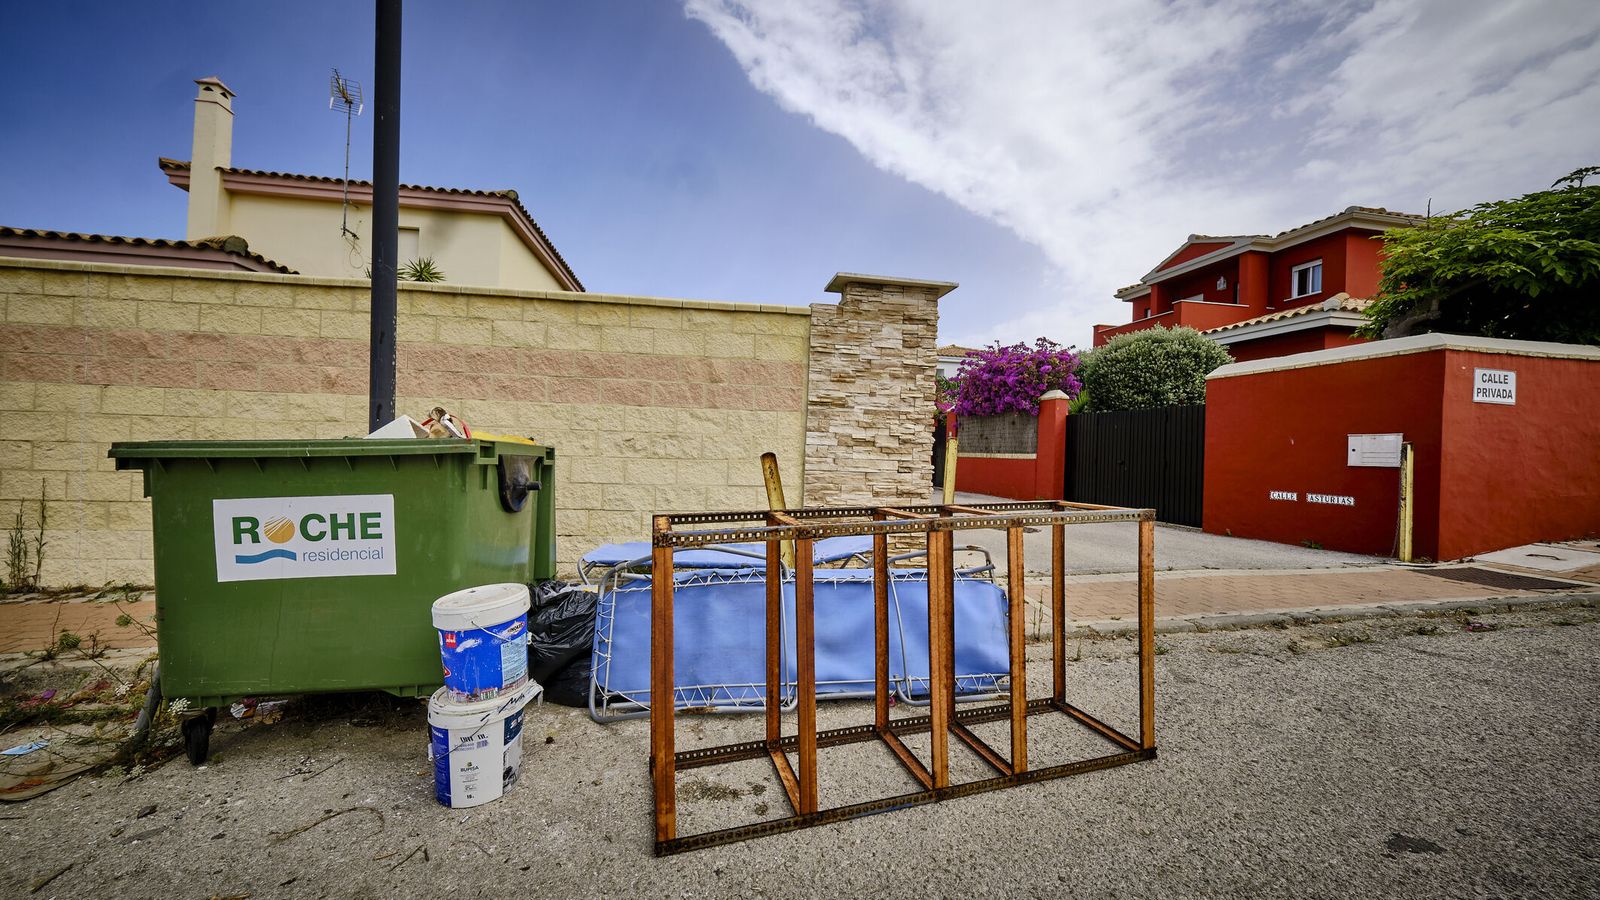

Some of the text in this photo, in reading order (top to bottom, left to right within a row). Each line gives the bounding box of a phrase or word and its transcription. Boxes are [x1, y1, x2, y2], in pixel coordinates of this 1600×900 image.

[1481, 373, 1509, 385] CALLE
[1476, 387, 1513, 399] PRIVADA
[1271, 491, 1354, 505] CALLE ASTURIAS
[232, 512, 383, 544] ROCHE
[303, 547, 384, 562] residencial
